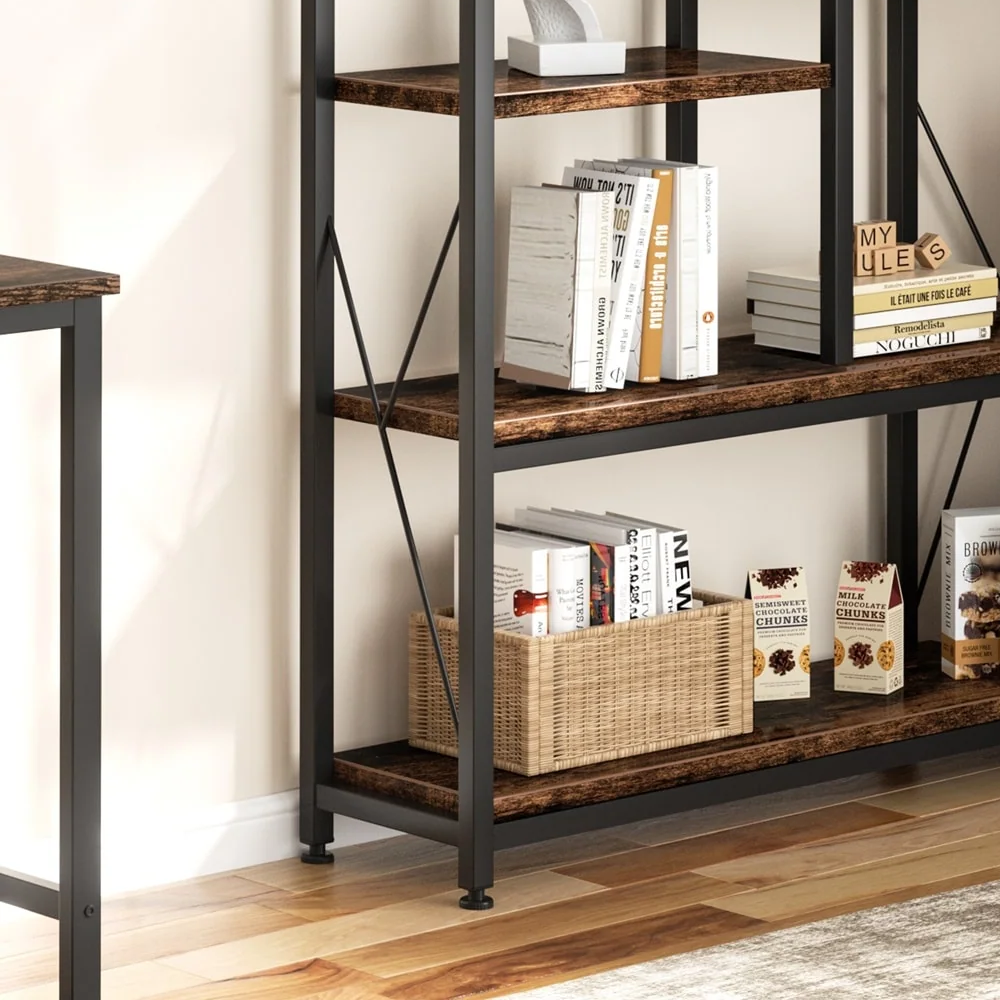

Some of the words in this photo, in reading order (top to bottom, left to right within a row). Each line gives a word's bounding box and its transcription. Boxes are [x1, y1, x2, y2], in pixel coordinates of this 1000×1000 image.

[860, 225, 892, 247] MY
[890, 295, 897, 306] IL
[898, 292, 915, 305] ÉTAIT
[916, 290, 930, 302] UNE
[931, 288, 945, 300] FOIS
[946, 287, 954, 299] LE
[955, 284, 972, 297] CAFÉ
[894, 320, 945, 334] Remodelista
[876, 331, 955, 354] NOGUCHI
[641, 535, 652, 583] Elliott
[673, 534, 692, 611] NEW
[576, 578, 584, 623] MOVIES
[838, 592, 864, 600] MILK
[755, 600, 806, 608] SEMISWEET
[837, 601, 887, 609] CHOCOLATE
[756, 607, 807, 616] CHOCOLATE
[836, 608, 886, 620] CHUNKS
[756, 615, 808, 626] CHUNKS
